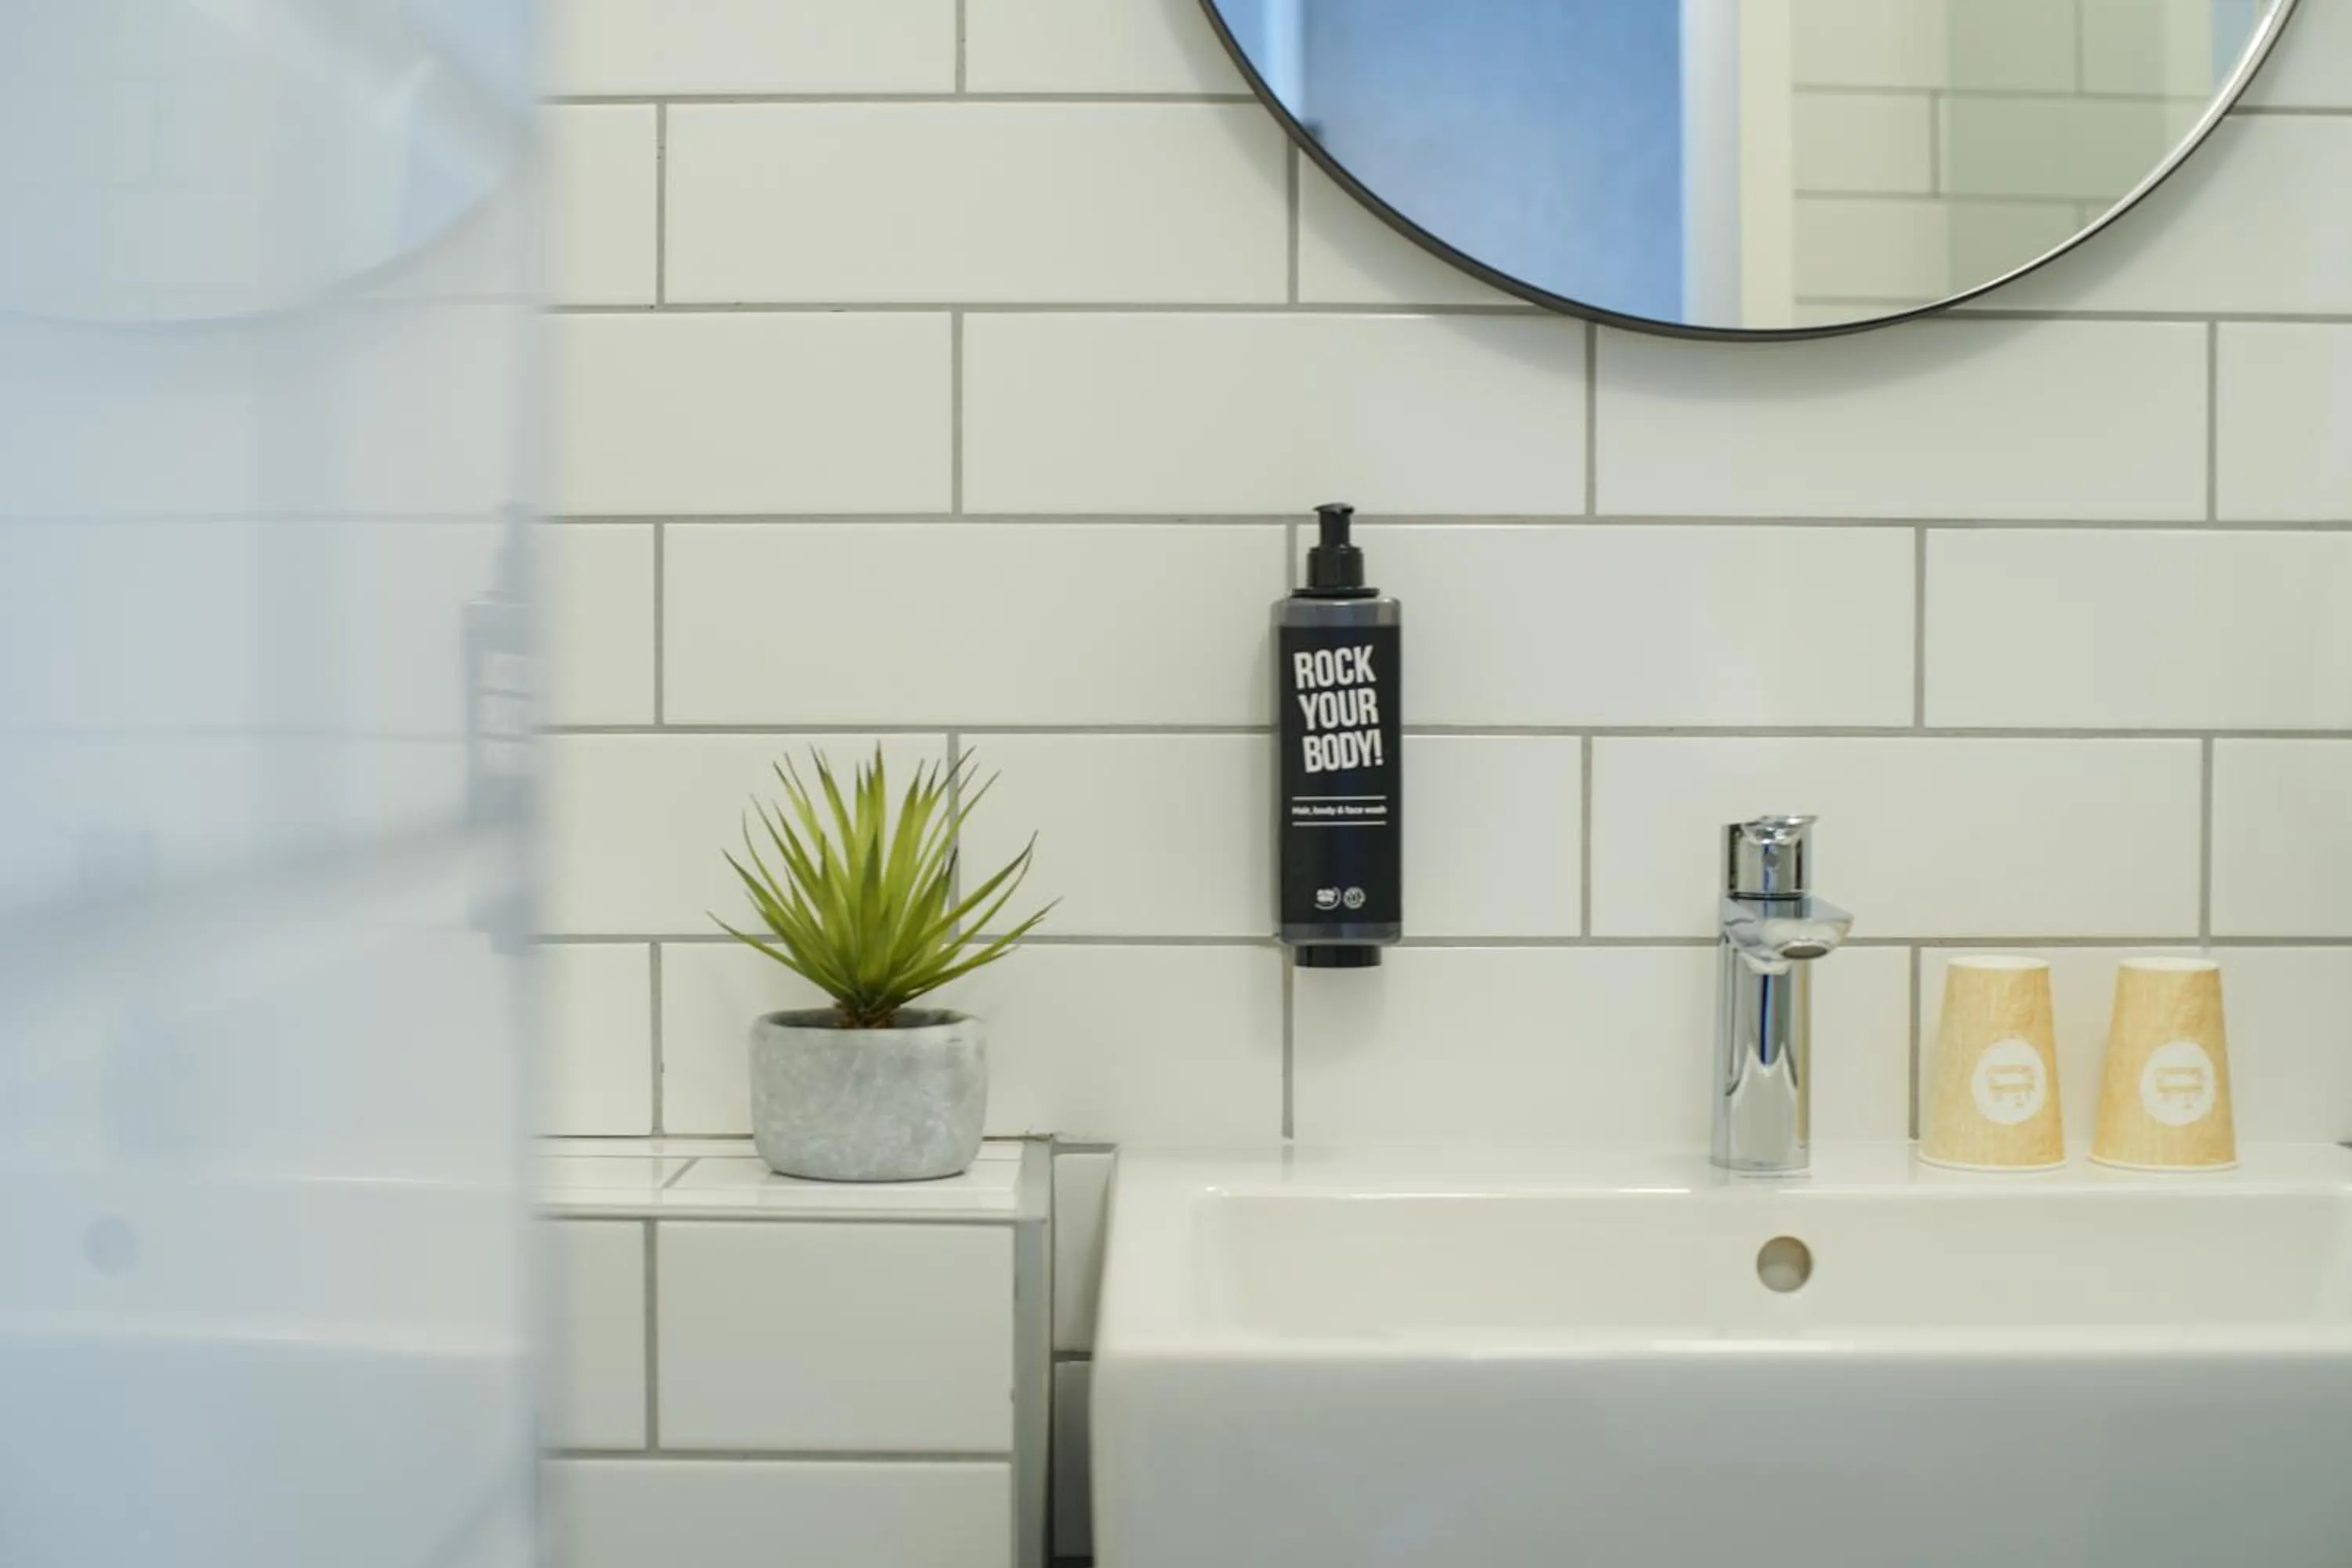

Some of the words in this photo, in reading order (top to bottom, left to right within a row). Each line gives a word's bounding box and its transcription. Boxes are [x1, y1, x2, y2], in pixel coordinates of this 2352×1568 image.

[1294, 644, 1377, 689] ROCK
[1298, 688, 1379, 731] YOUR
[1302, 728, 1384, 773] BODY!
